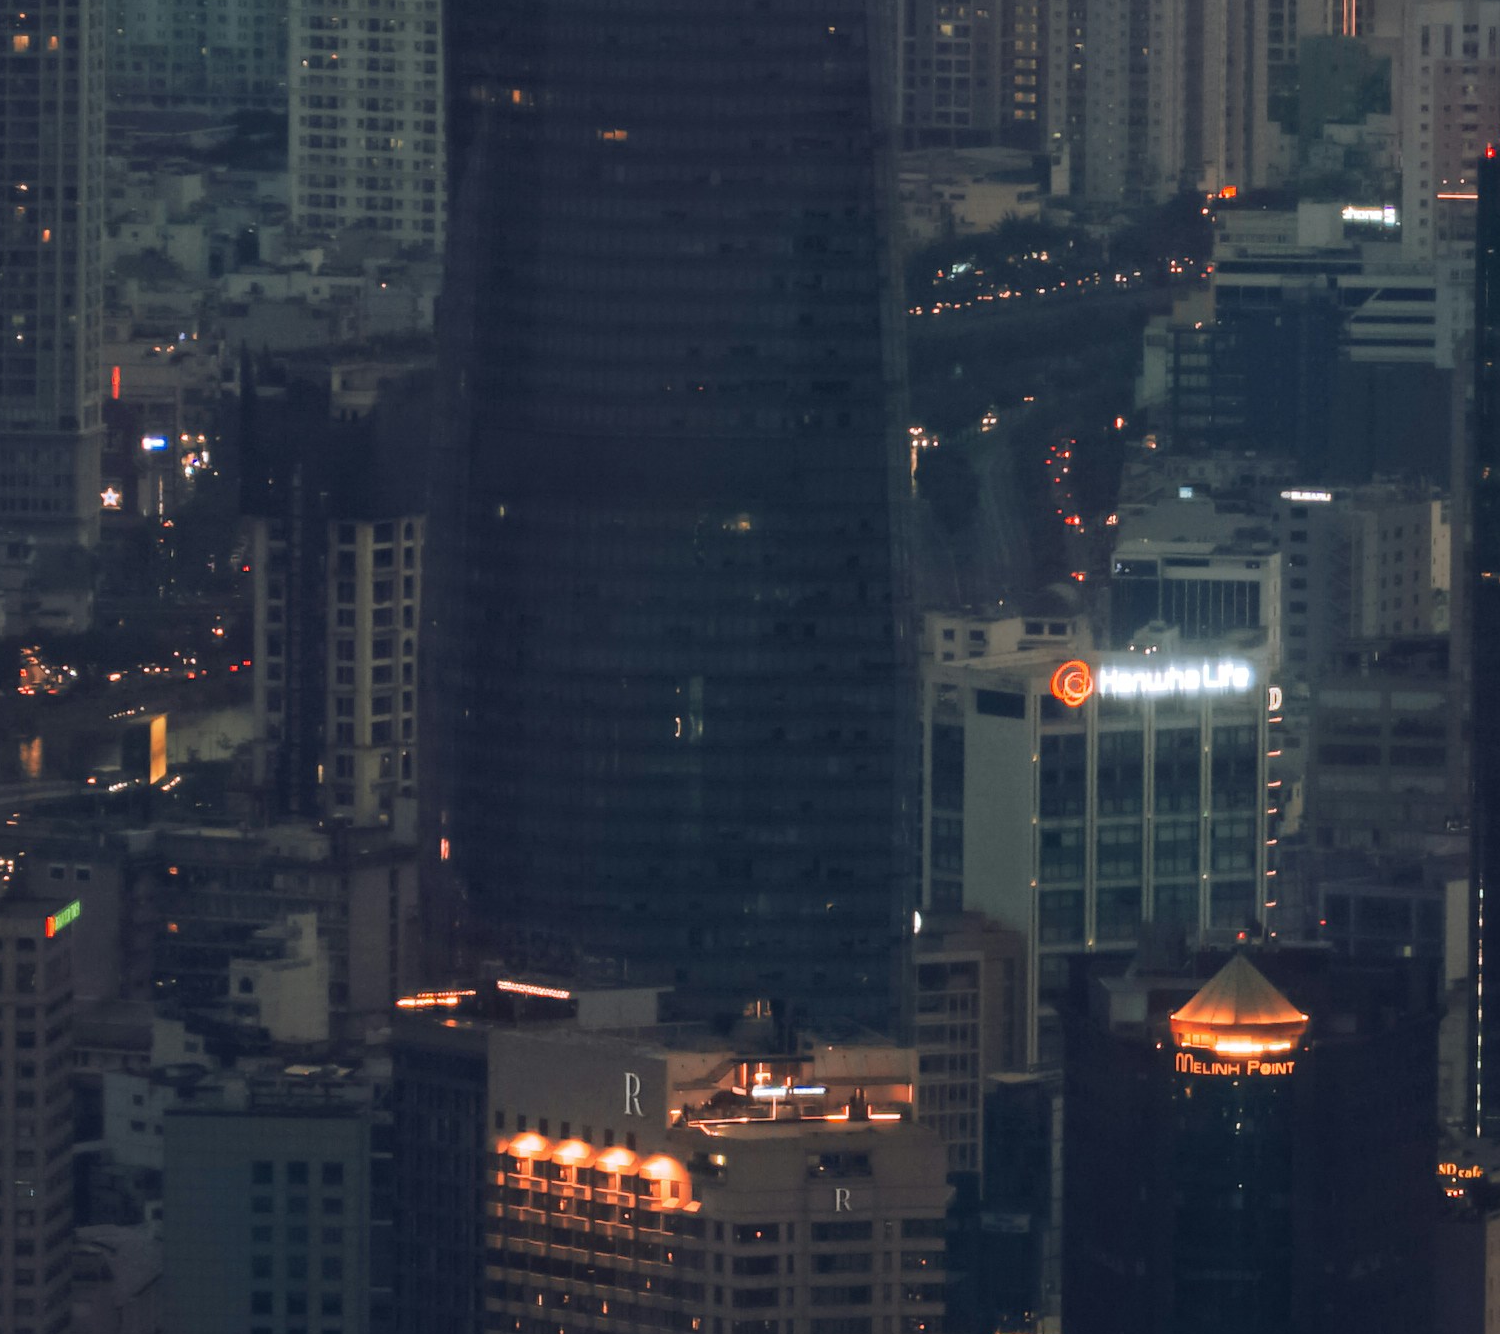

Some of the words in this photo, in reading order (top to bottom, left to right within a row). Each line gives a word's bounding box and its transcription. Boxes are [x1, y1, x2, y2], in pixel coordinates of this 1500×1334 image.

[1100, 668, 1201, 695] Hanwha
[1203, 664, 1251, 691] Life
[1247, 1059, 1296, 1076] POINT
[624, 1072, 644, 1118] R
[835, 1188, 852, 1213] R
